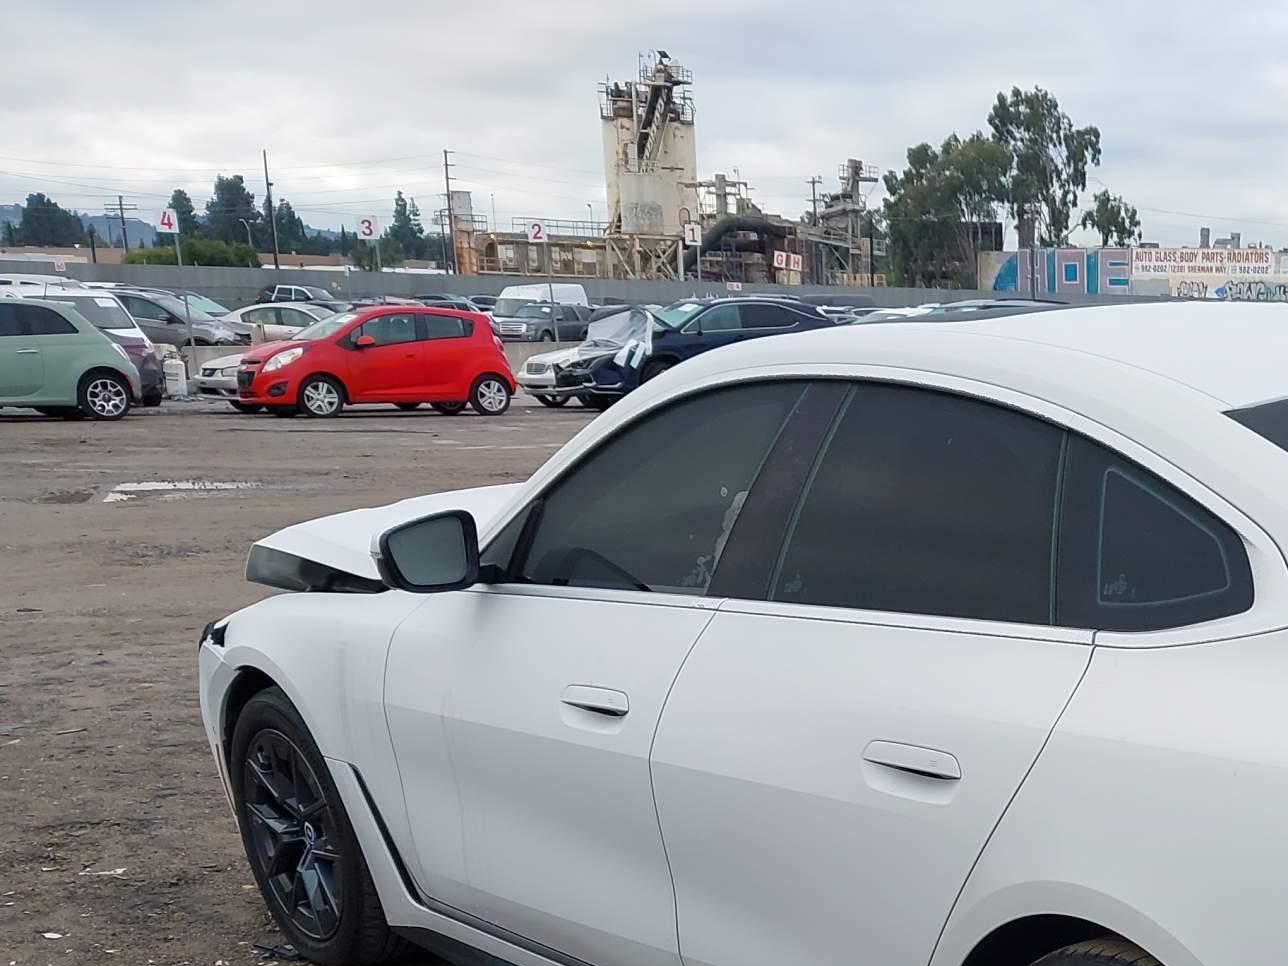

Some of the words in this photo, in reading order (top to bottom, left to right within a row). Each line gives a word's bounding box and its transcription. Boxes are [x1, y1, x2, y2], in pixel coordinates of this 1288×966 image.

[161, 211, 173, 230] 4
[360, 219, 373, 236] 3
[532, 223, 543, 240] 2
[688, 228, 698, 242] 1
[775, 254, 785, 266] G
[792, 257, 800, 269] H
[1135, 251, 1153, 262] AUTO
